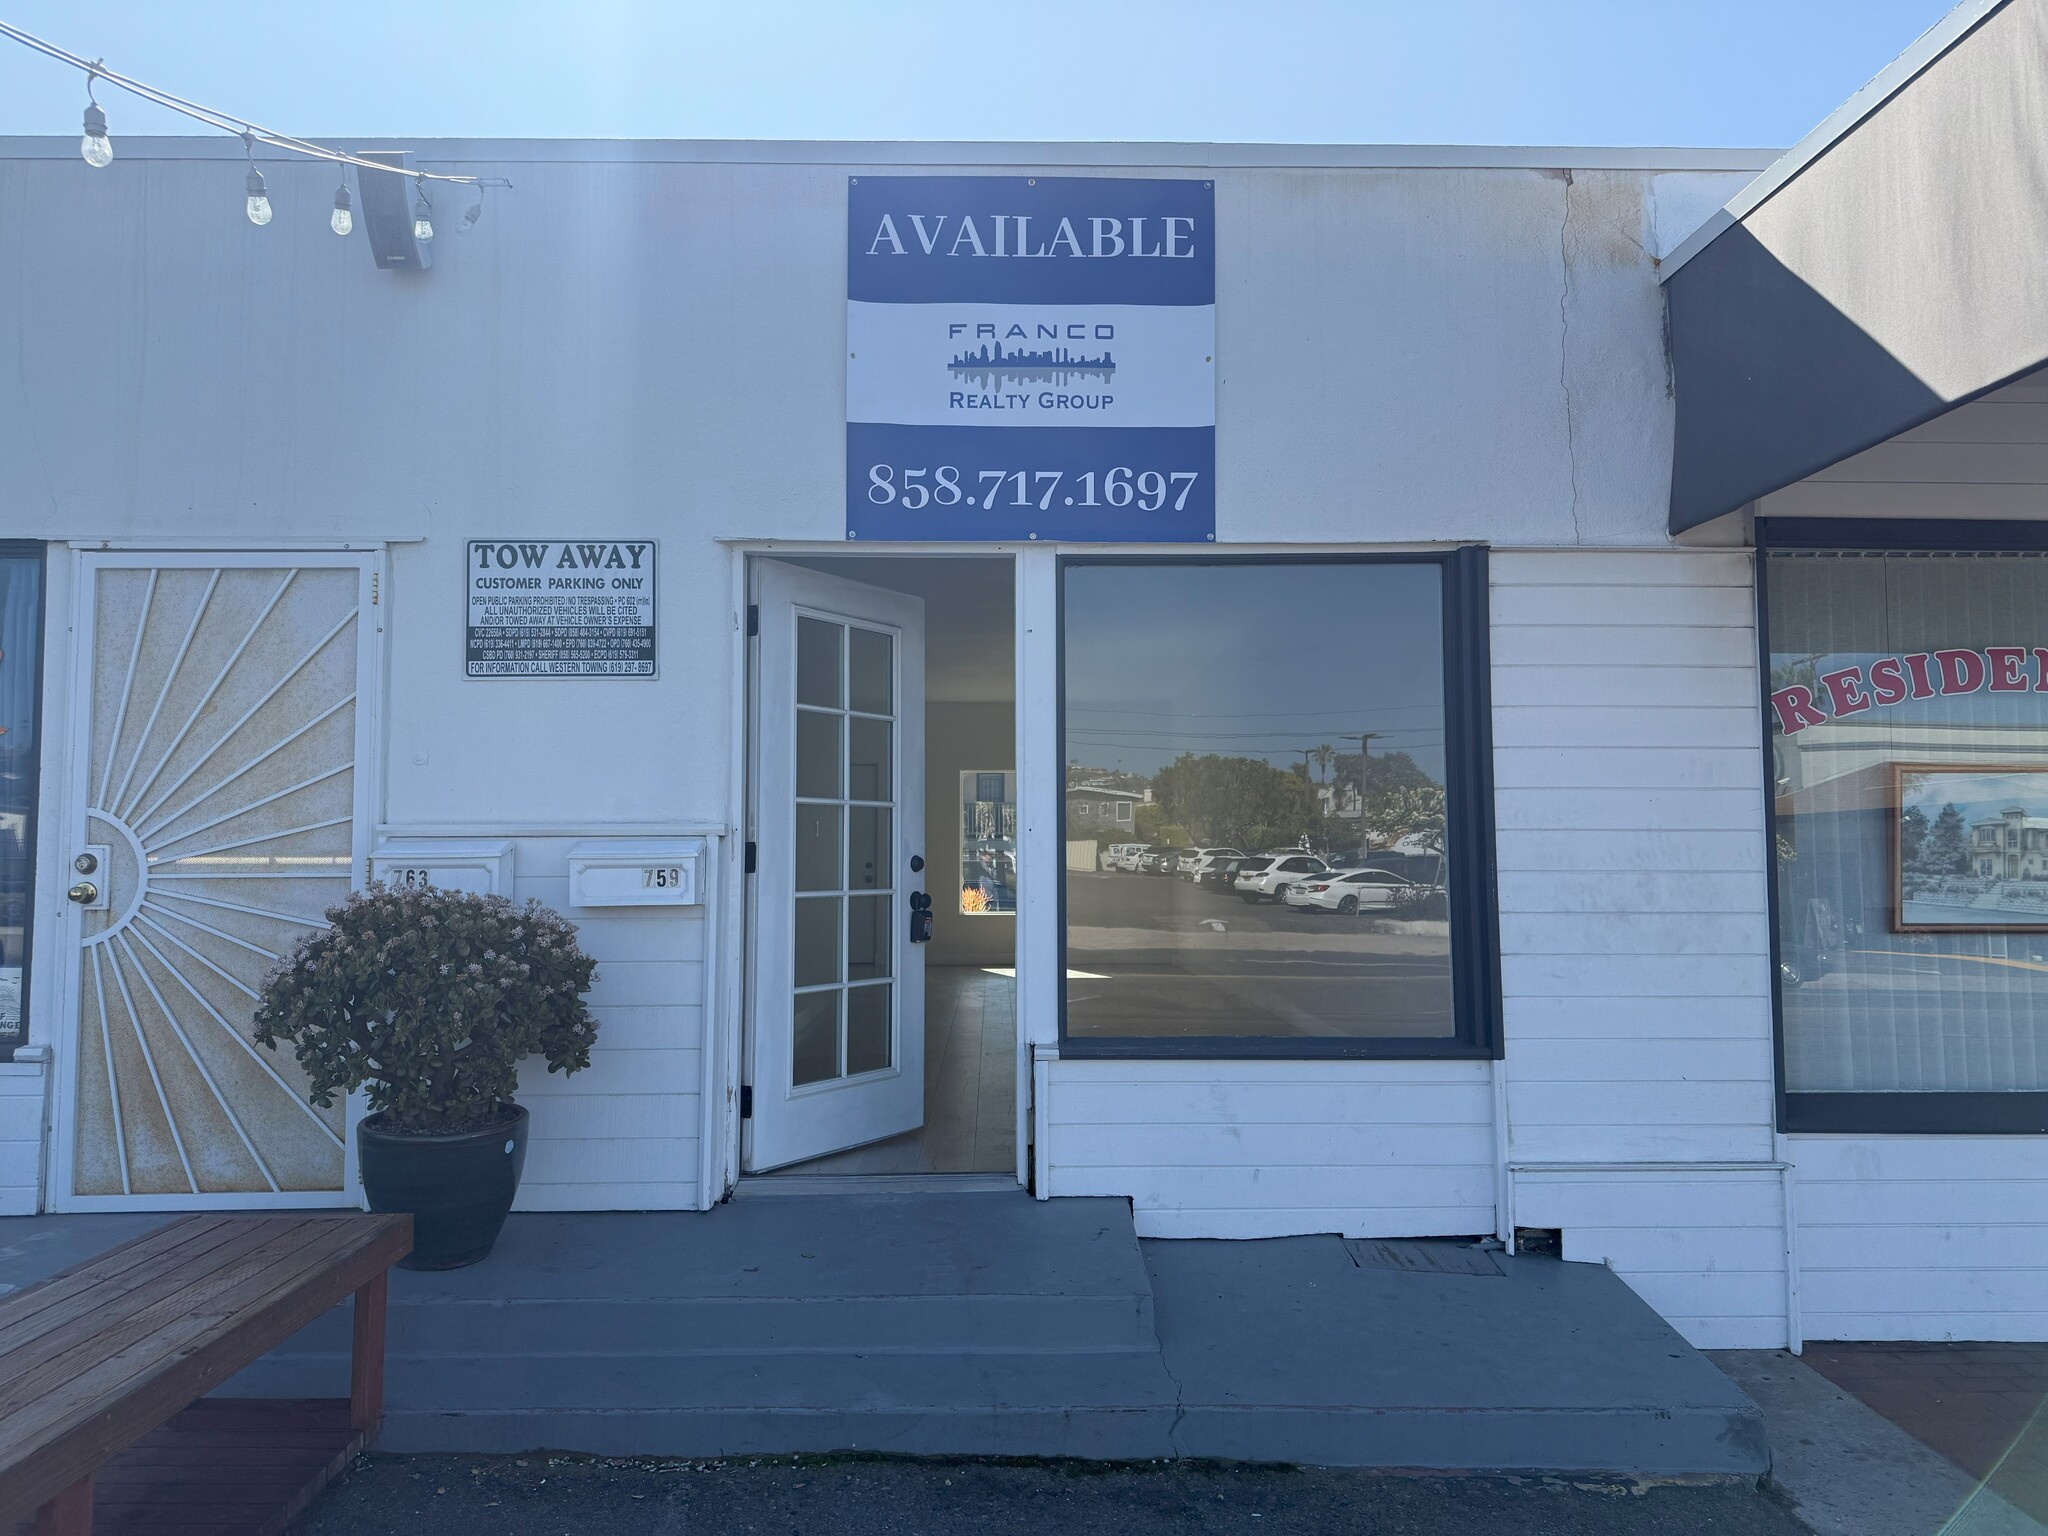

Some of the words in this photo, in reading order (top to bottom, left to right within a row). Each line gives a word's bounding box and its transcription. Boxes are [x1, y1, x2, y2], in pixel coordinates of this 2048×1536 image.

[866, 214, 1195, 258] AVAILABLE
[949, 324, 1115, 340] FRANCO
[950, 392, 1030, 409] REALTY
[1038, 392, 1114, 409] GROUP
[868, 464, 1199, 511] 858.717.1697
[474, 544, 549, 569] TOW
[556, 544, 646, 569] AWAY
[476, 578, 542, 590] CUSTOMER
[548, 578, 605, 590] PARKING
[612, 578, 644, 590] ONLY
[472, 596, 487, 605] OPEN
[488, 596, 507, 605] PUBLIC
[508, 596, 532, 605] PARKING
[577, 596, 614, 605] TRESPASSING
[618, 596, 625, 605] PC
[484, 606, 498, 616] ALL
[499, 606, 552, 616] UNAUTHORIZED
[554, 606, 587, 616] VEHICLES
[588, 606, 605, 616] WILL
[606, 606, 616, 616] BE
[617, 606, 638, 616] CITED
[480, 616, 504, 625] AND/OR
[506, 616, 528, 625] TOWED
[529, 616, 546, 625] AWAY
[547, 616, 555, 625] AT
[556, 616, 582, 625] VEHICLE
[583, 616, 612, 625] OWNER'S
[613, 616, 642, 625] EXPENSE
[538, 650, 558, 660] SHERIFF
[470, 662, 484, 673] FOR
[486, 662, 530, 673] INFORMATION
[531, 662, 547, 673] CALL
[548, 662, 580, 673] WESTERN
[582, 662, 608, 673] TOWING
[608, 662, 623, 673] (619)
[394, 870, 428, 887] 763
[644, 869, 678, 887] 759
